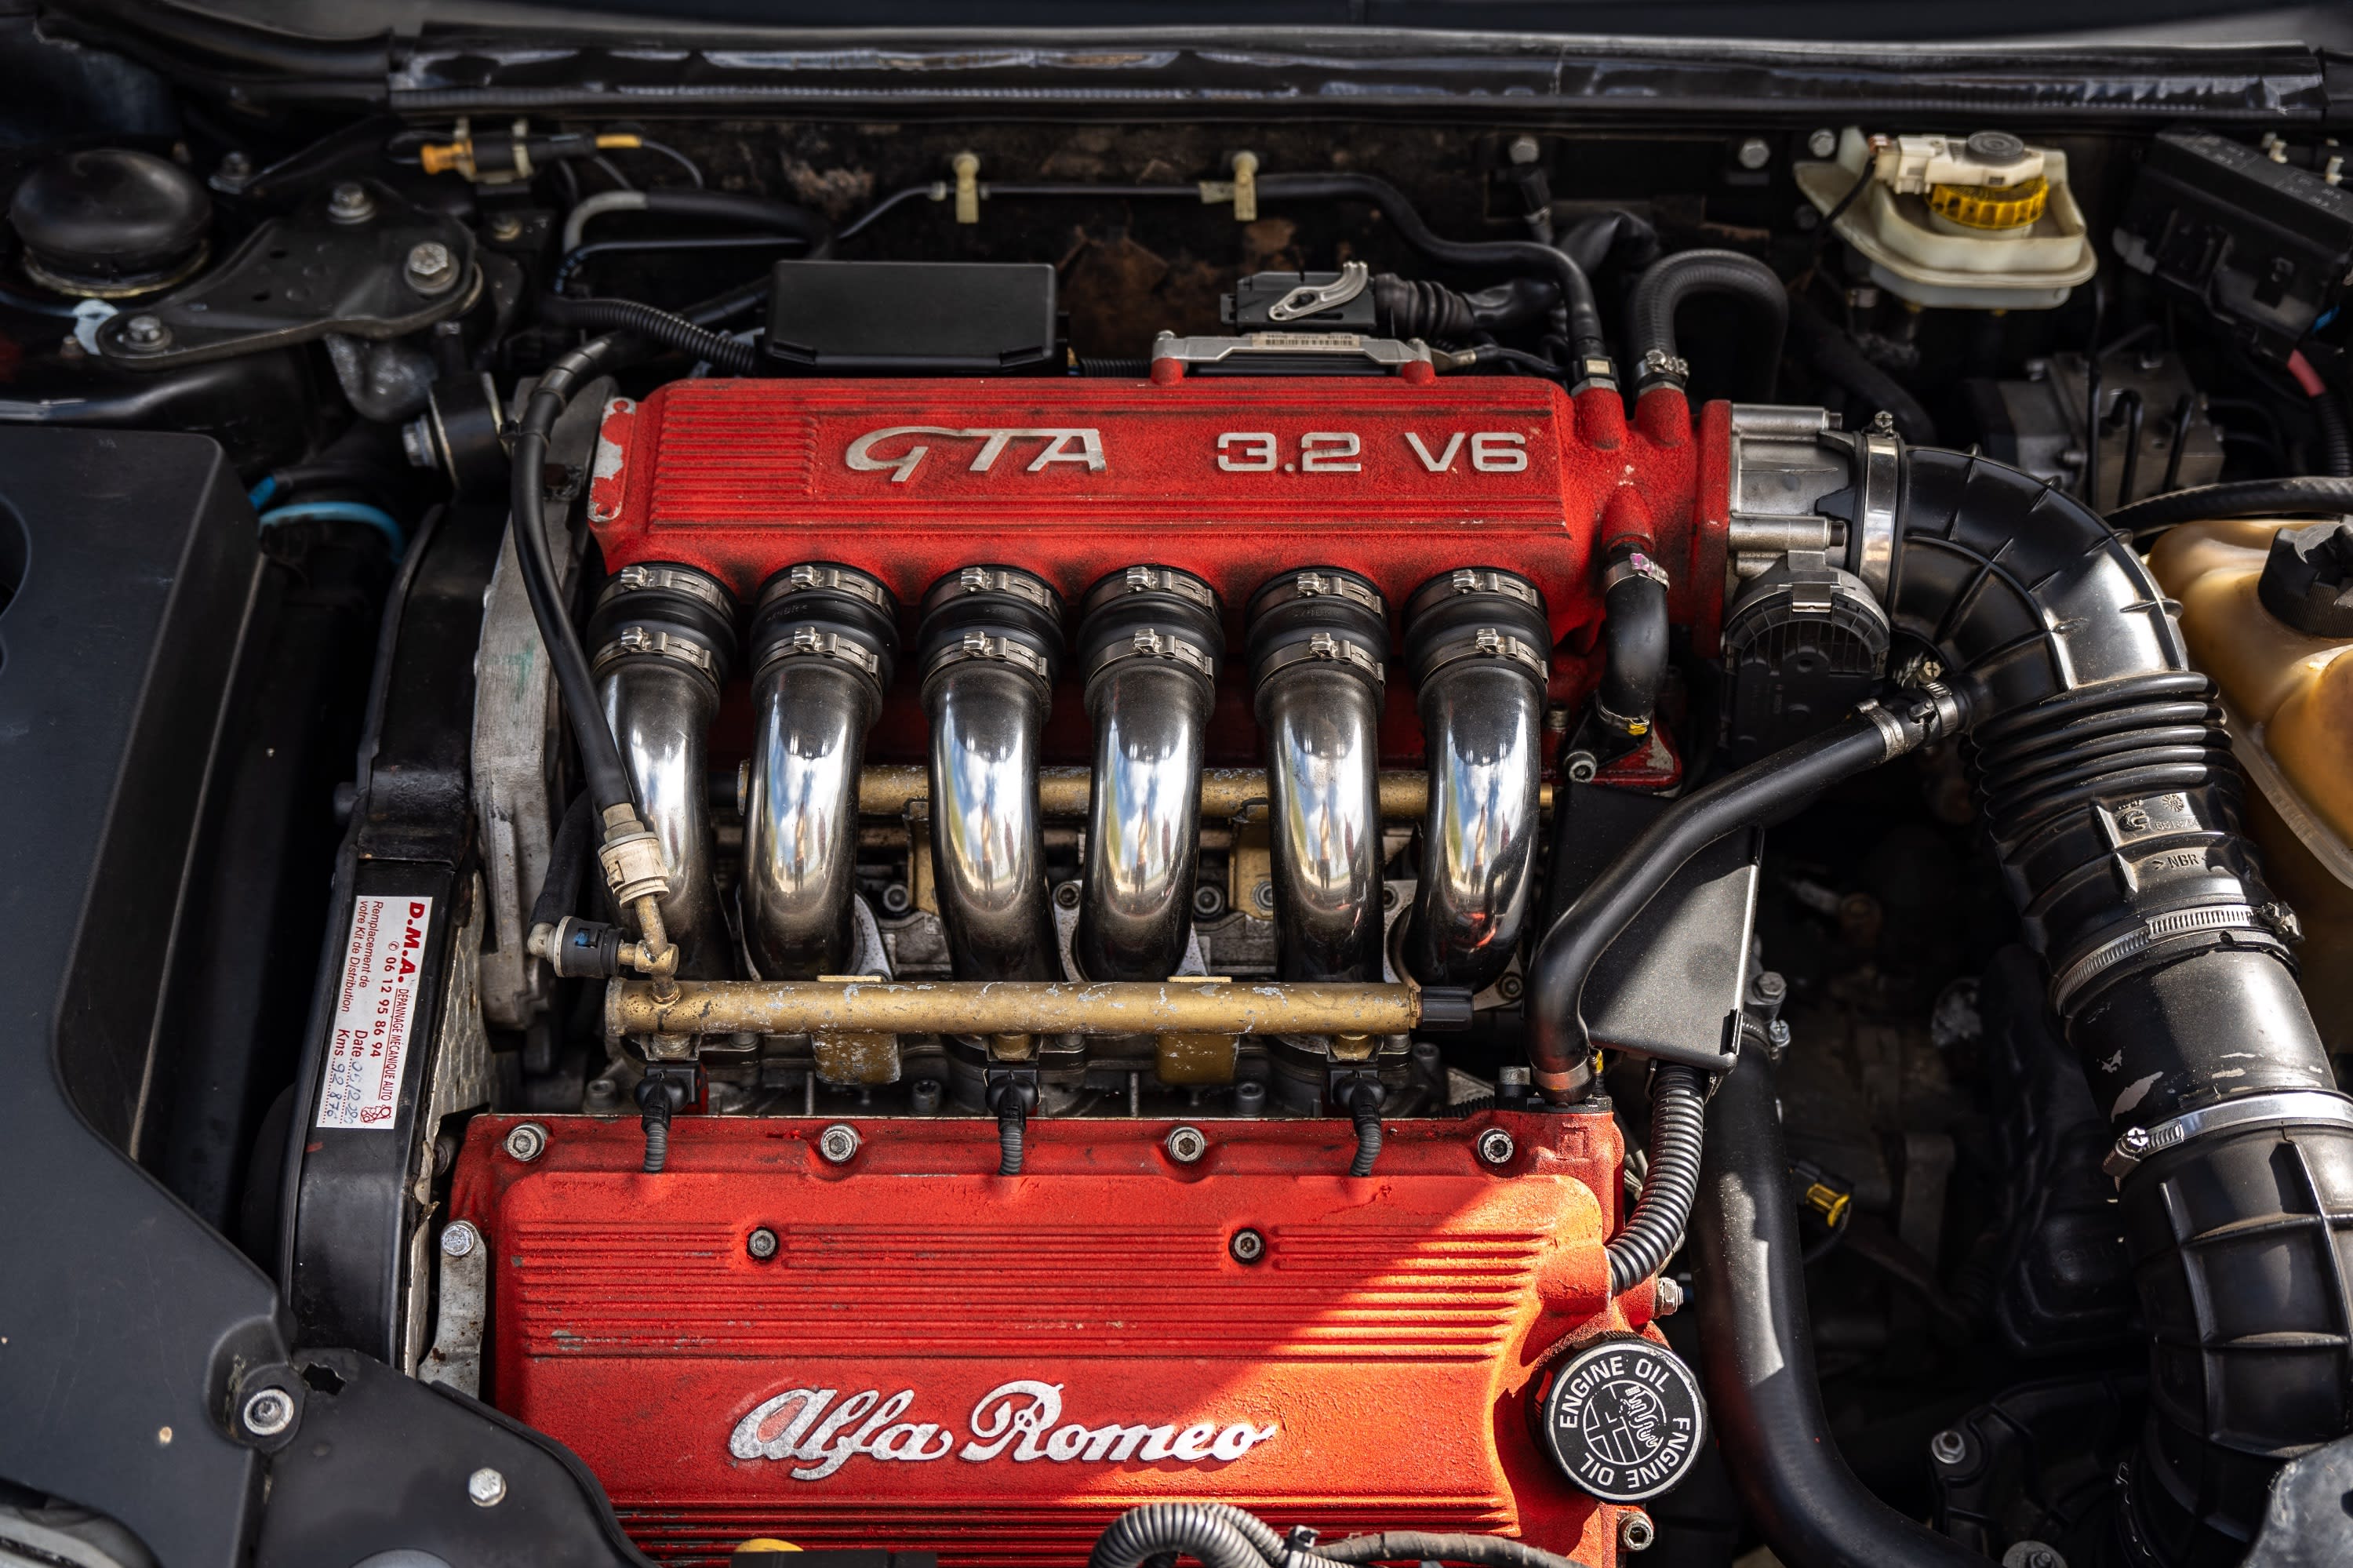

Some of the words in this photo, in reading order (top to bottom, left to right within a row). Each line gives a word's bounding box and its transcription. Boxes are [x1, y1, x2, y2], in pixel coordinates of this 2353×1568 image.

[846, 426, 1107, 482] GTA
[1217, 432, 1362, 471] 3.2
[1405, 432, 1528, 471] V6
[357, 901, 368, 924] votre
[355, 926, 365, 939] Kit
[362, 900, 384, 973] Remplacement
[398, 902, 425, 983] D.M.A.
[352, 941, 362, 954] de
[384, 957, 397, 972] 06
[342, 957, 360, 1013] Distribution
[359, 974, 370, 988] de
[381, 979, 393, 993] 12
[377, 999, 390, 1014] 95
[392, 988, 411, 1033] DÉPANNAGE
[373, 1020, 386, 1035] 86
[334, 1028, 351, 1057] Kms
[352, 1029, 369, 1057] Date
[370, 1042, 383, 1057] 94
[384, 1035, 403, 1079] MÉCANIQUE
[380, 1080, 394, 1101] AUTO
[1560, 1355, 1625, 1428] ENGINE
[1635, 1358, 1670, 1393] OIL
[729, 1388, 952, 1481] Alfa
[958, 1380, 1277, 1464] Romeo
[1580, 1452, 1615, 1486] OIL
